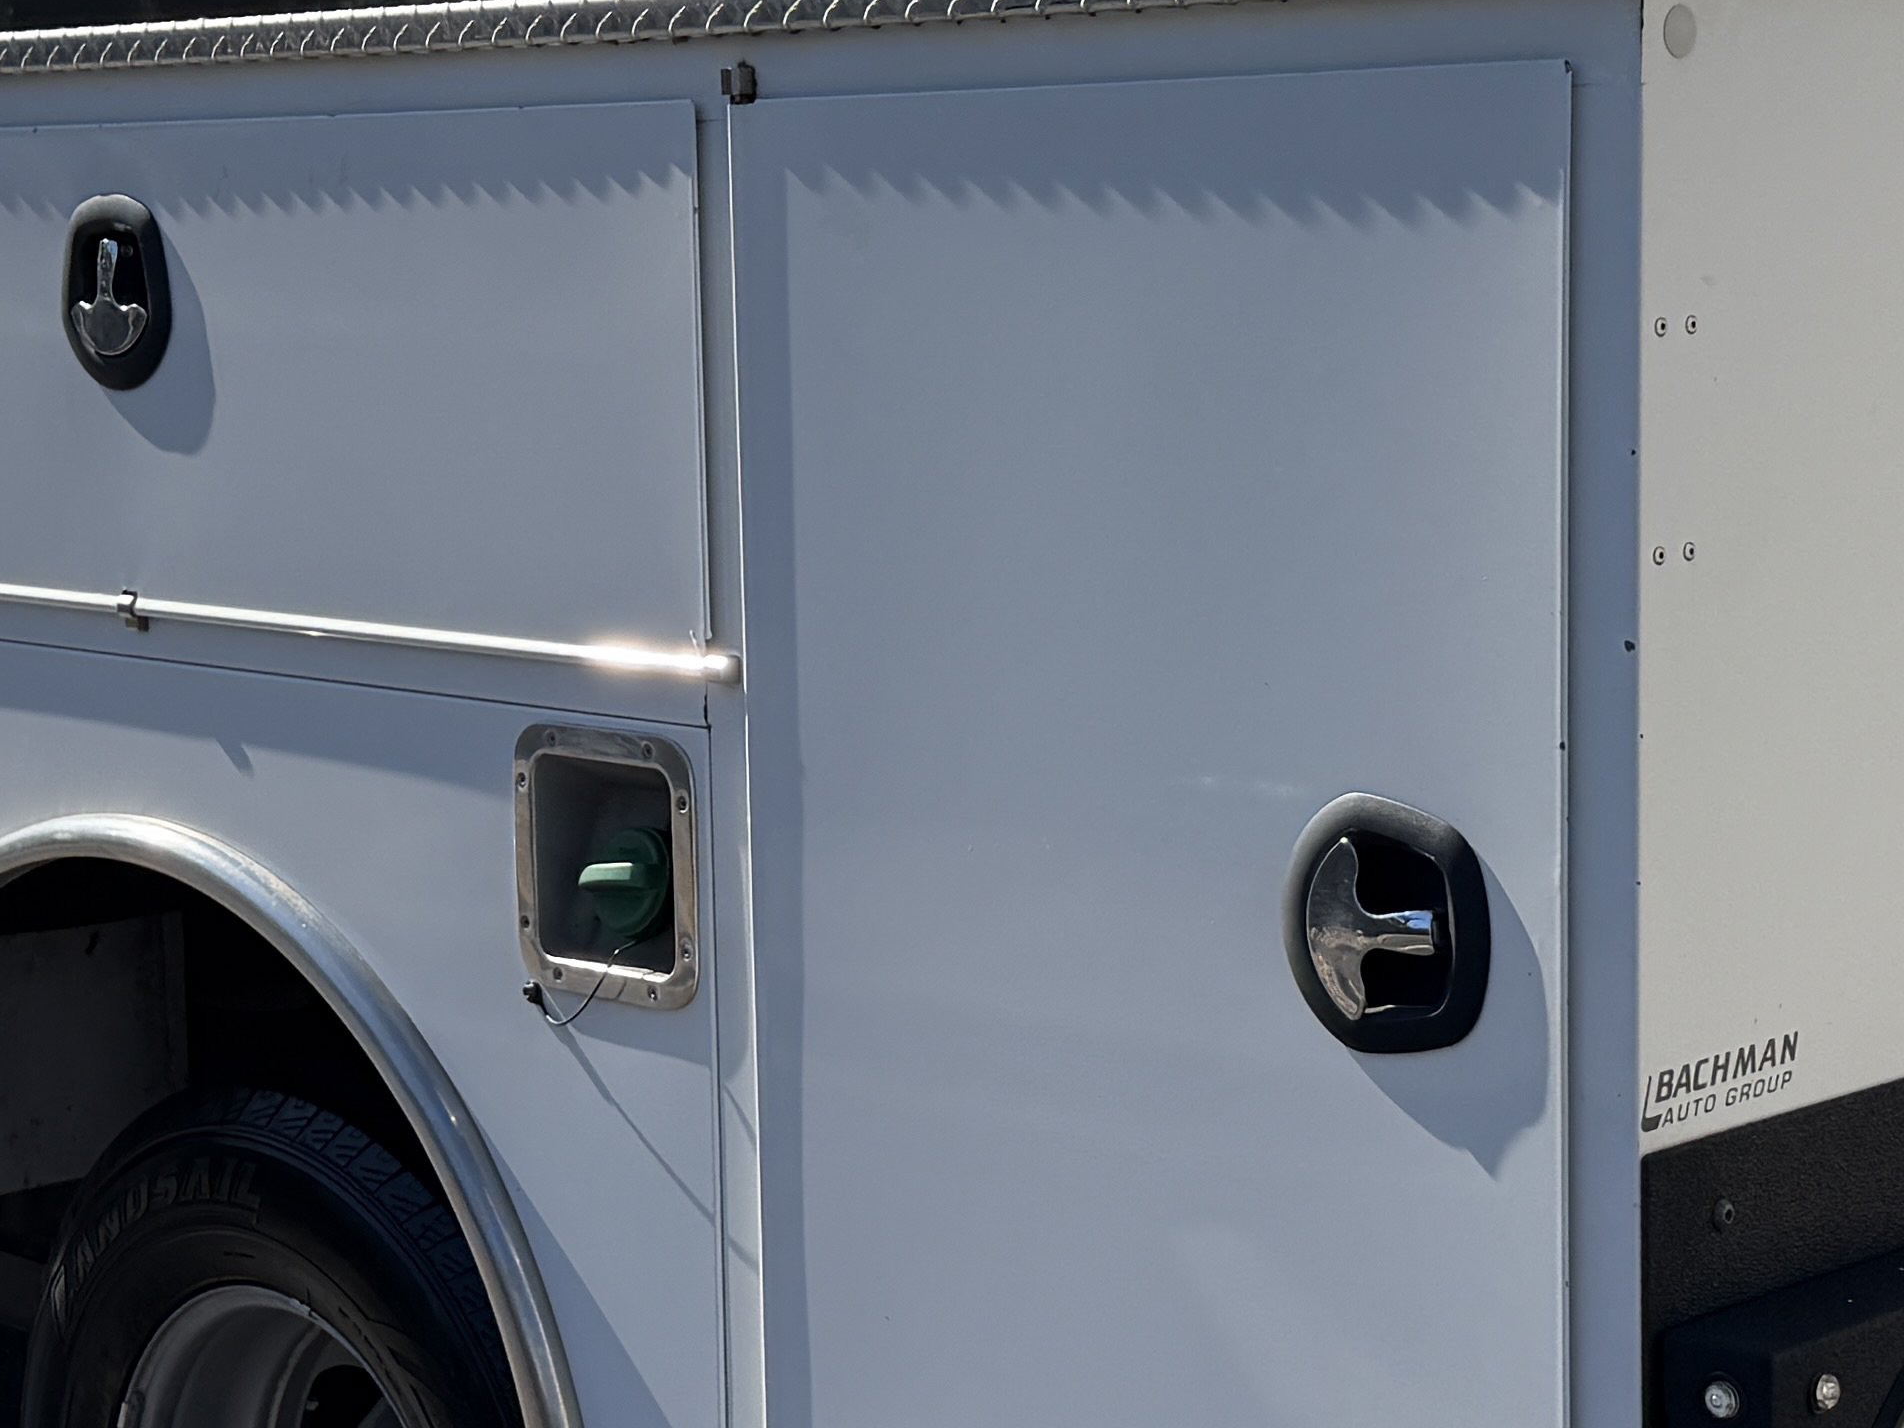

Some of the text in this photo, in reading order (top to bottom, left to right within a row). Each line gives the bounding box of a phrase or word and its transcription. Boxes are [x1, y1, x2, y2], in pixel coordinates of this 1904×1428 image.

[1654, 1030, 1799, 1104] BACHMAN
[1661, 1070, 1793, 1128] AUTO GROUP
